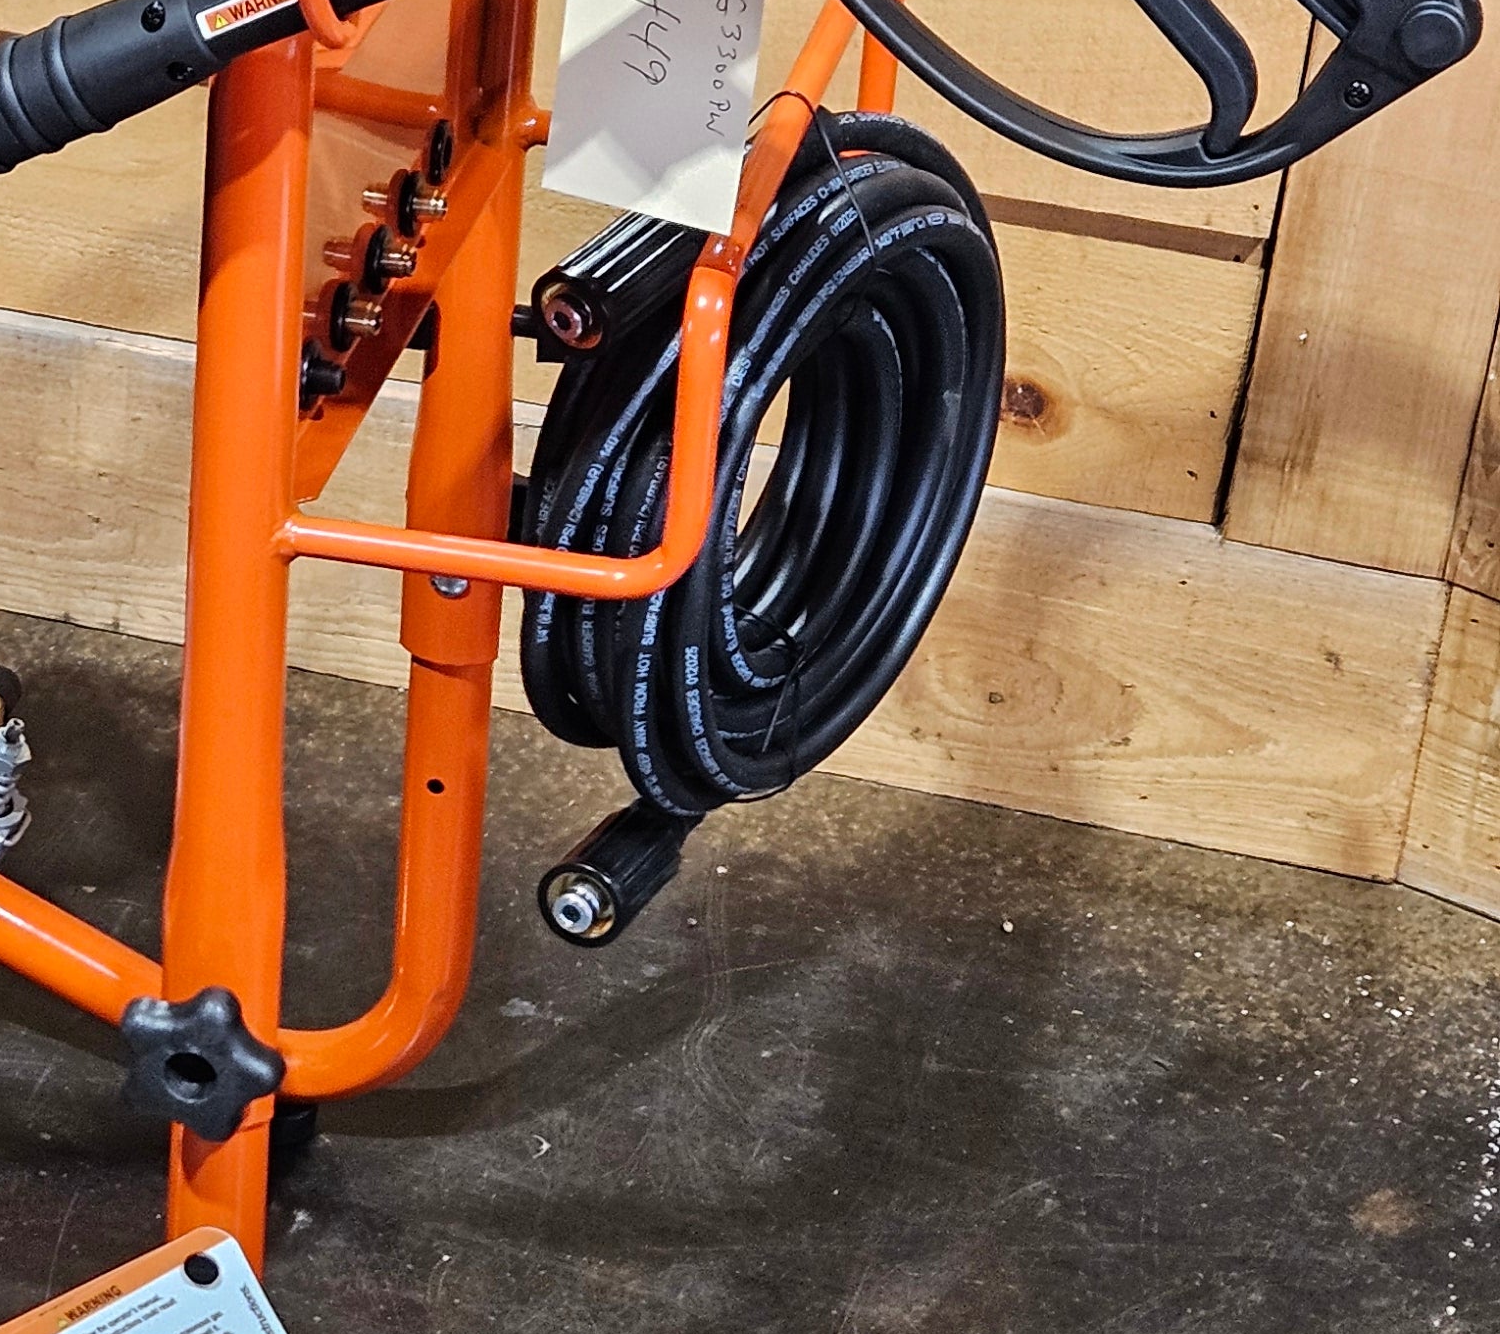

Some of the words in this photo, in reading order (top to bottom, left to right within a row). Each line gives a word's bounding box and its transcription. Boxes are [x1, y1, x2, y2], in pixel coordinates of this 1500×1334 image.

[770, 194, 819, 243] SURFACES
[787, 234, 831, 287] CHAUDES
[721, 571, 732, 597] DES
[636, 652, 651, 677] HOT
[680, 644, 703, 685] 012025
[632, 680, 648, 714] FROM
[684, 688, 706, 736] CHAUDES
[631, 719, 648, 747] AWAY
[62, 1283, 123, 1322] WARNING
